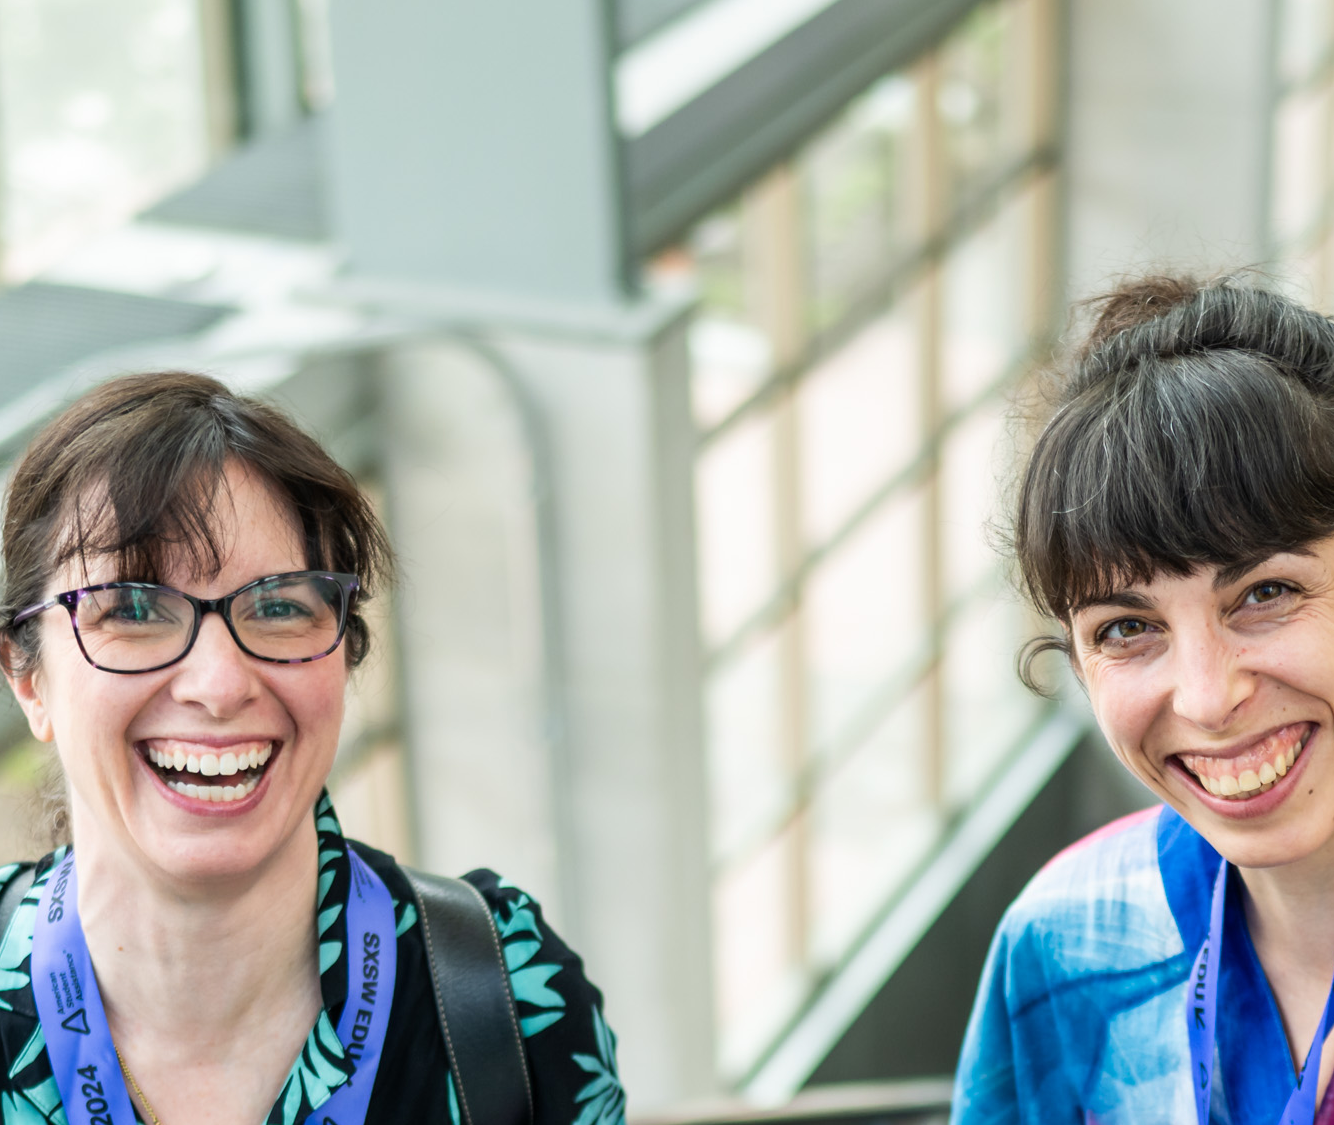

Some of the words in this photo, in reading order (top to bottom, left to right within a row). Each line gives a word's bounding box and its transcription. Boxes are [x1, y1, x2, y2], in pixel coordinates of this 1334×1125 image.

[48, 860, 74, 924] SXSW
[49, 972, 65, 1014] American
[59, 972, 74, 1008] Student
[361, 932, 380, 1005] SXSW
[347, 1008, 373, 1061] EDU
